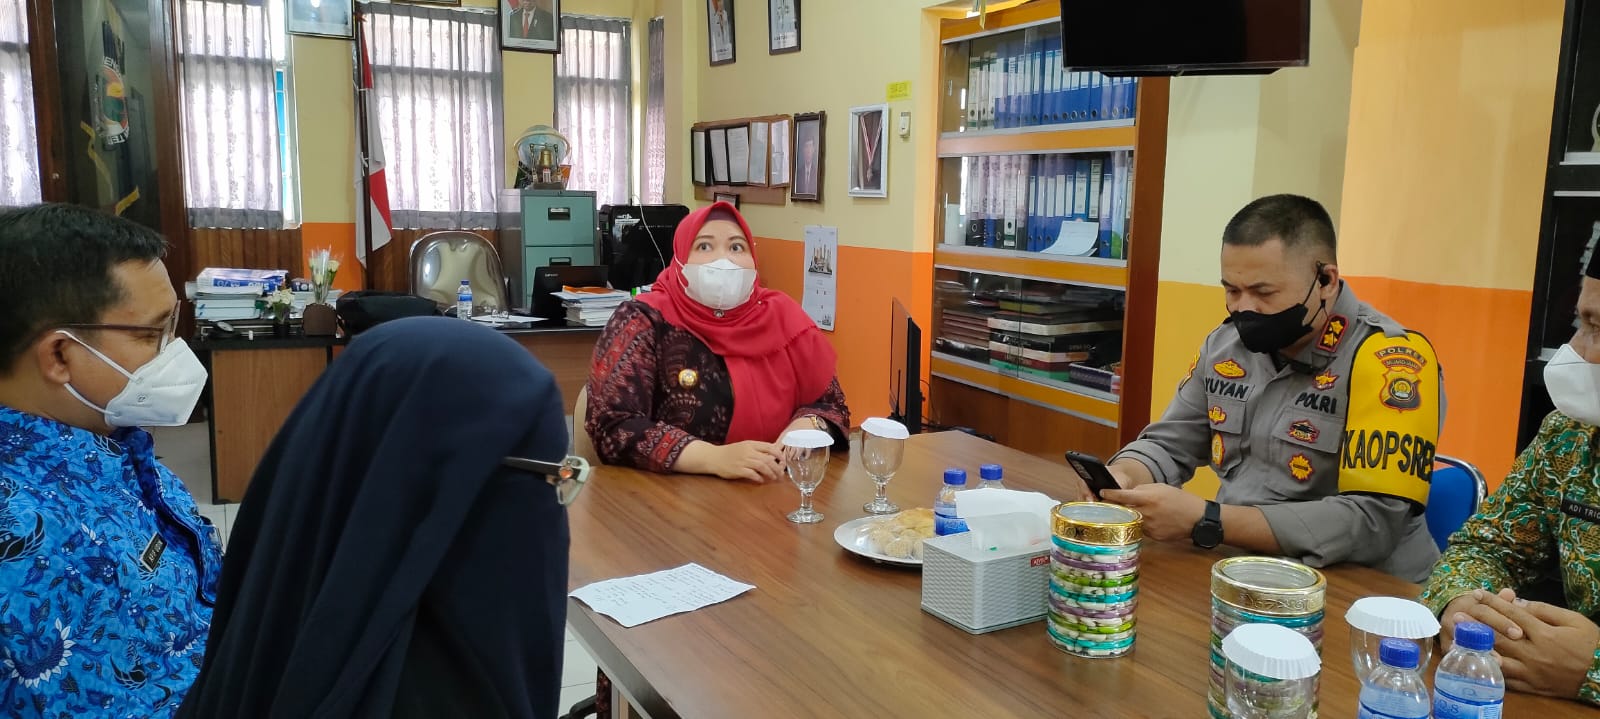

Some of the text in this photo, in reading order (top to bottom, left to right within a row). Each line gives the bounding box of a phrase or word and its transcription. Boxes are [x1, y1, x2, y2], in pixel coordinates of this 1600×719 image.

[1379, 348, 1425, 363] POLRES
[1205, 377, 1249, 399] YUYAN
[1295, 392, 1337, 414] POLRI
[1569, 504, 1582, 513] ADI
